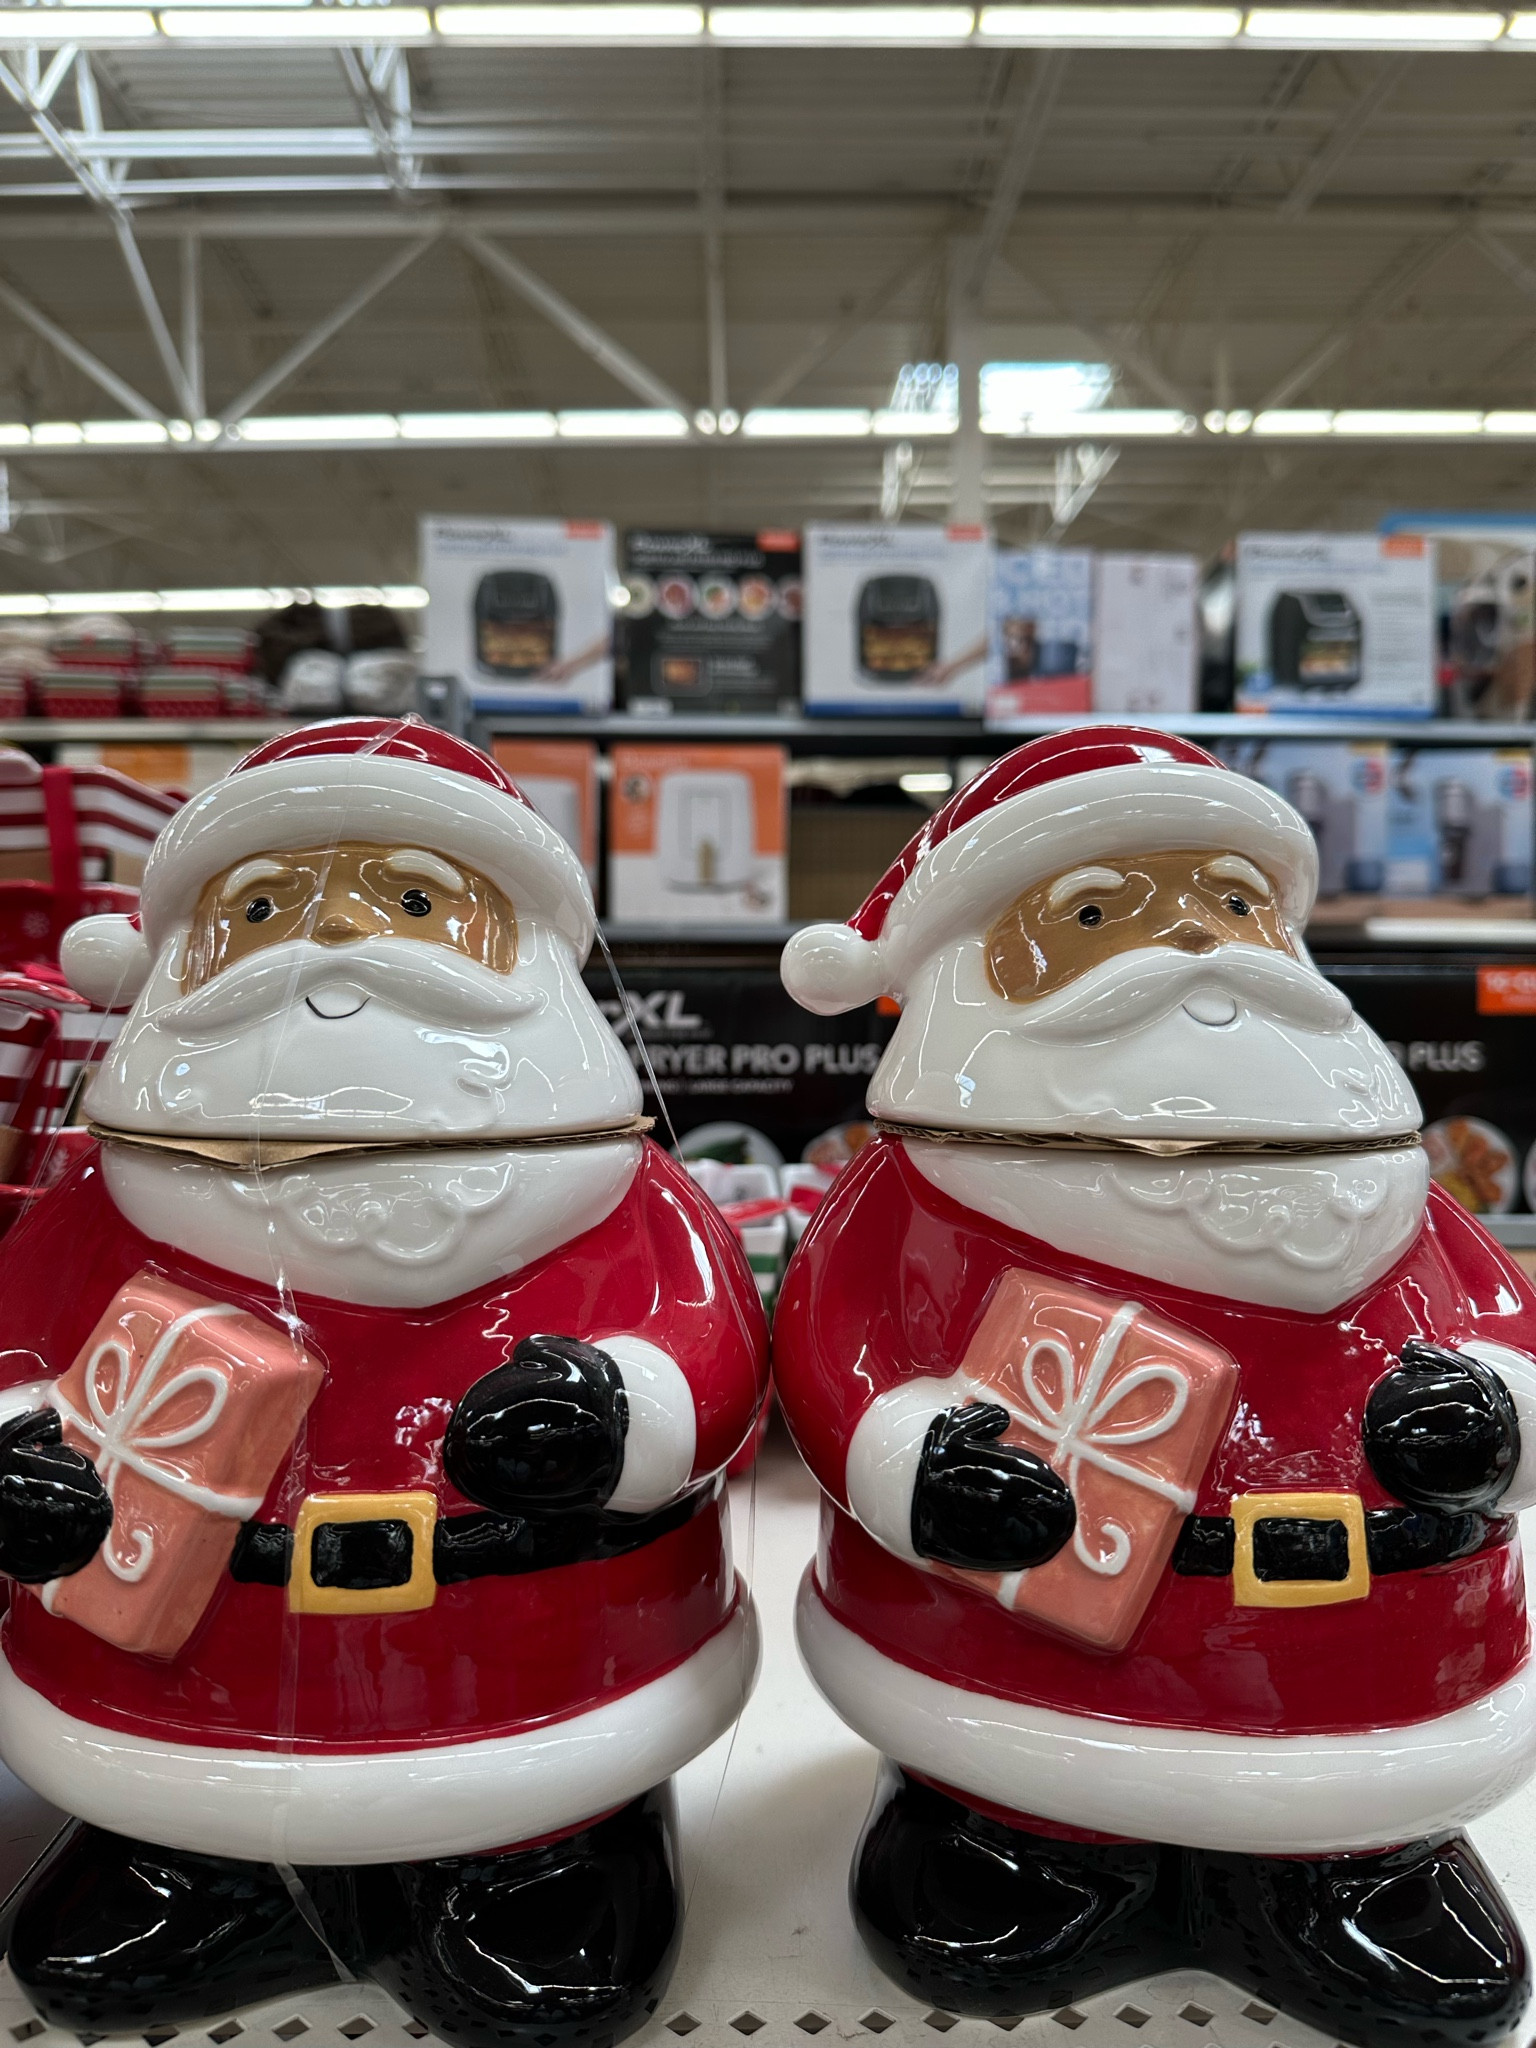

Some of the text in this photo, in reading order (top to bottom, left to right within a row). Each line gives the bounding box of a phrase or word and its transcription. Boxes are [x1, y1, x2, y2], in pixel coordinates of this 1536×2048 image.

[730, 1043, 801, 1075] PRO
[803, 1043, 881, 1075] PLUS
[1407, 1040, 1483, 1071] PLUS
